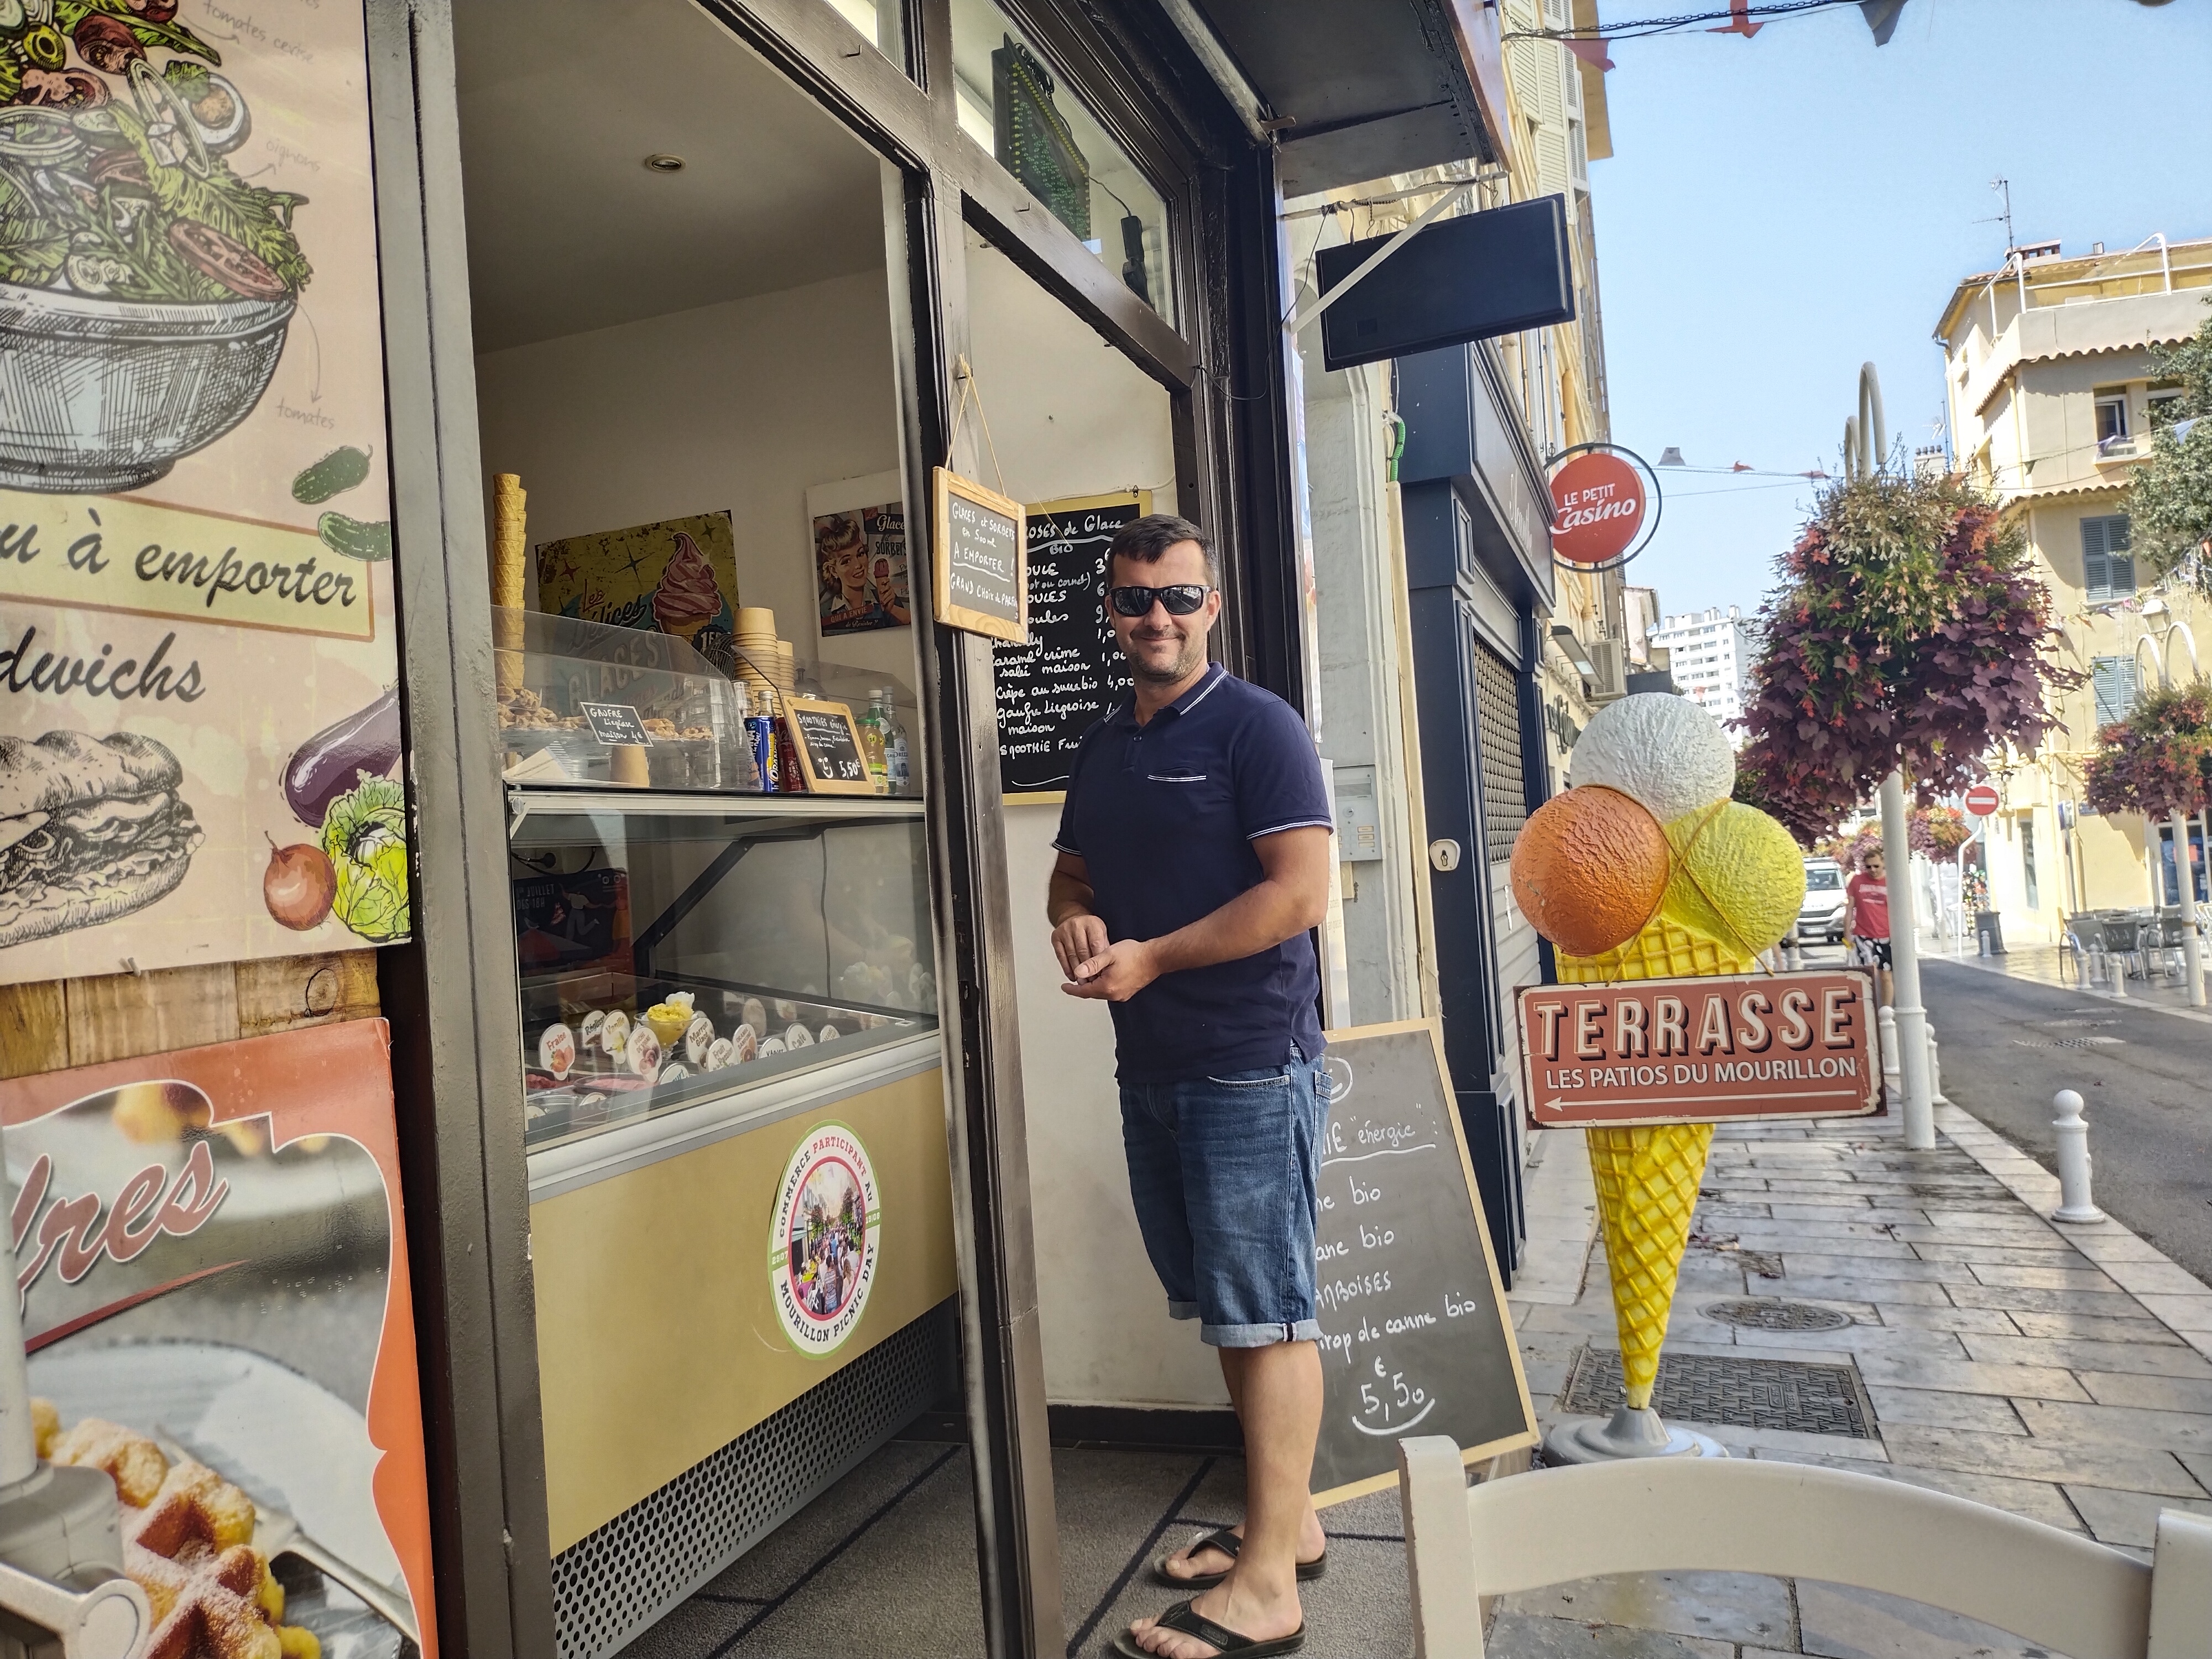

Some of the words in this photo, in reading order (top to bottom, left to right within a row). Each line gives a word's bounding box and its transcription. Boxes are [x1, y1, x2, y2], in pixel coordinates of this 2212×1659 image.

[203, 1, 267, 42] tomates
[276, 398, 335, 430] tomates
[1564, 492, 1578, 507] LE
[1583, 483, 1616, 503] PETIT
[877, 515, 905, 531] Glace
[952, 502, 976, 524] GLACES
[980, 516, 988, 527] et
[989, 519, 1015, 541] SORBETS
[1027, 523, 1056, 539] OSES
[1064, 520, 1079, 536] de
[1084, 514, 1125, 532] Glace
[1549, 498, 1637, 535] Casino
[962, 526, 971, 538] en
[0, 523, 40, 564] u
[67, 507, 109, 575] à
[135, 544, 357, 609] emporter
[875, 540, 907, 556] SORBETS
[954, 541, 960, 559] A
[964, 546, 1005, 573] EMPORTER
[1050, 543, 1073, 555] BIO
[1027, 562, 1059, 576] OULE
[582, 578, 606, 613] Les
[951, 572, 974, 595] GRAND
[995, 592, 1001, 603] de
[1027, 590, 1067, 604] OULES
[831, 615, 842, 623] QUI
[849, 607, 867, 617] ENVIE
[1027, 610, 1069, 625] oules
[568, 630, 662, 716] GLACES
[1042, 660, 1091, 675] maison
[1031, 687, 1050, 697] au
[1082, 675, 1098, 690] bio
[1107, 674, 1135, 691] 4,00
[589, 707, 623, 718] GAUFRE
[598, 730, 628, 739] maison
[1008, 723, 1055, 735] maison
[839, 758, 860, 779] 5,50€
[527, 884, 555, 897] JUILLET
[606, 1016, 625, 1035] Vanille
[688, 1021, 708, 1044] Marron
[1532, 985, 1856, 1062] TERRASSE
[546, 1031, 567, 1051] Fraise
[712, 1044, 726, 1060] Fruit
[1546, 1067, 1584, 1090] LES
[1590, 1065, 1669, 1088] PATIOS
[1674, 1063, 1709, 1086] DU
[1714, 1056, 1858, 1084] MOURILLON
[779, 1150, 811, 1238] COMMERCE
[812, 1135, 867, 1178] PARTICIPANT
[864, 1181, 873, 1203] AU
[1349, 1175, 1381, 1205] bio
[1359, 1224, 1395, 1249] bio
[780, 1279, 830, 1343] MOURILLON
[833, 1287, 864, 1338] PICNIC
[862, 1242, 874, 1283] DAY
[1358, 1316, 1381, 1342] de
[1386, 1312, 1437, 1334] canne
[1444, 1291, 1477, 1317] bio
[1360, 1371, 1425, 1422] 5,50
